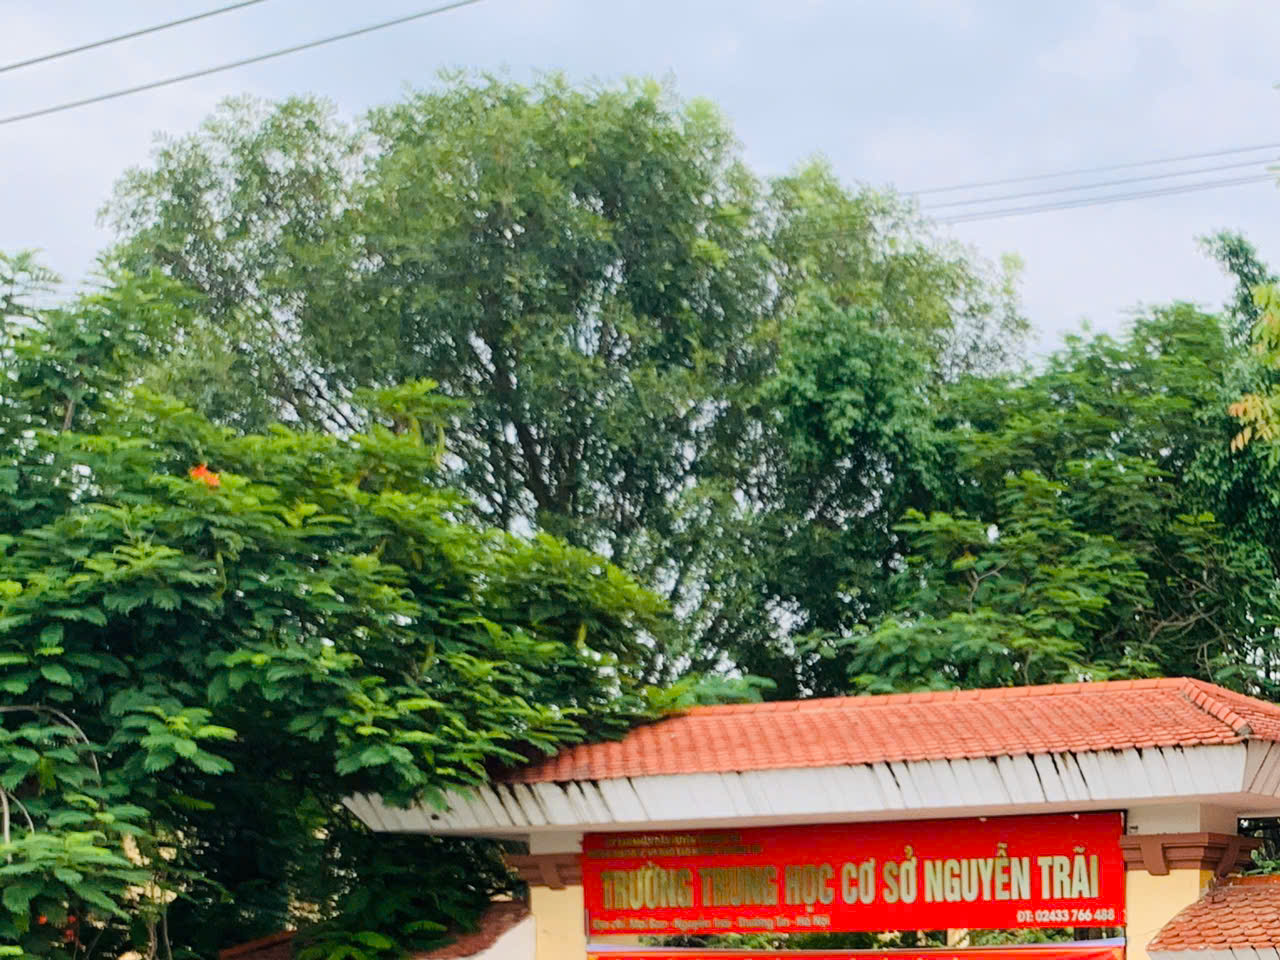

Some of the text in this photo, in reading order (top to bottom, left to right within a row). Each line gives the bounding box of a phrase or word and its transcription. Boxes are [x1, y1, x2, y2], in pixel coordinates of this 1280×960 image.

[602, 842, 1099, 913] TRƯỜNG TRUNG HỌC CƠ SỞ NGUYỄN TRÃI
[1071, 908, 1092, 921] 766
